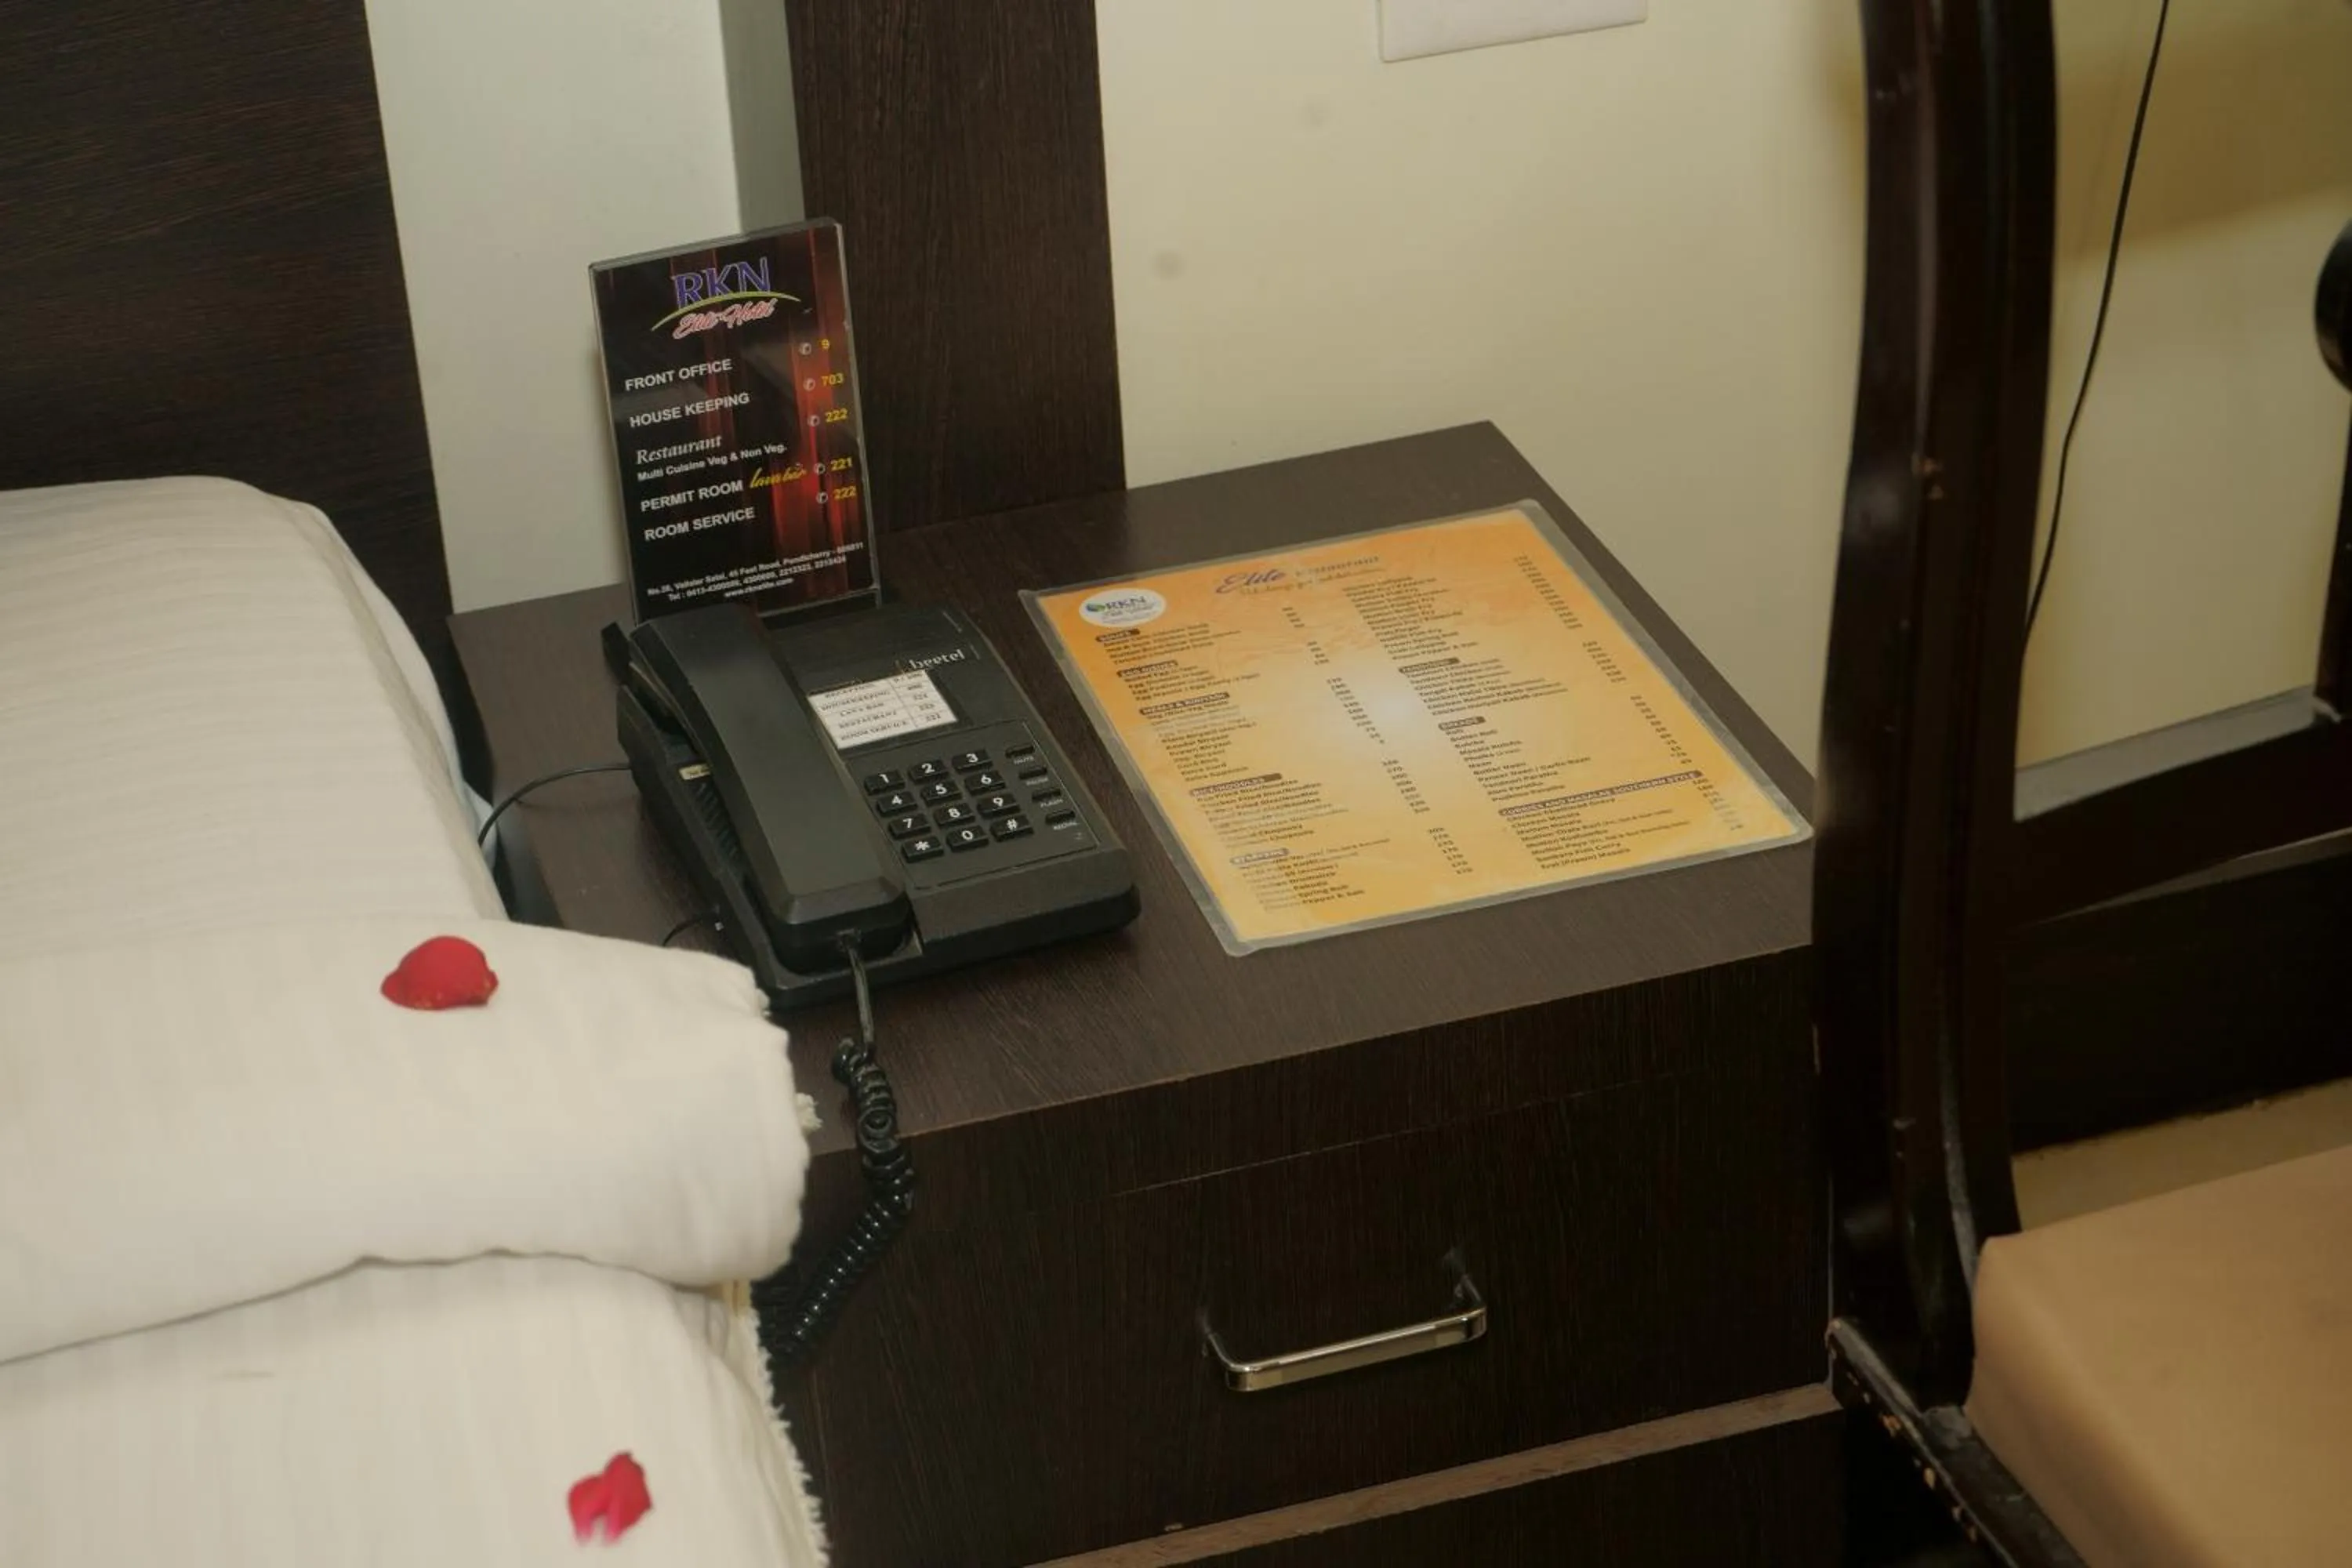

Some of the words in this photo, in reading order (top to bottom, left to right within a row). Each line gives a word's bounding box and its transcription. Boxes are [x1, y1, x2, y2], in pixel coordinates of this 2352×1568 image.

[672, 256, 771, 309] RKN
[821, 338, 830, 350] 9
[625, 372, 674, 391] FRONT
[678, 358, 733, 382] OFFICE
[821, 373, 844, 387] 703
[630, 406, 682, 428] HOUSE
[685, 392, 750, 416] KEEPING
[826, 408, 848, 423] 222
[636, 435, 722, 465] Restaurant
[637, 467, 664, 482] Multi
[666, 459, 706, 476] Cuisine
[708, 454, 729, 469] Veg
[730, 451, 739, 462] &
[740, 448, 763, 459] Non
[831, 457, 853, 472] 221
[641, 489, 696, 512] PERMIT
[699, 480, 743, 499] ROOM
[833, 485, 856, 500] 222
[644, 520, 690, 541] ROOM
[693, 507, 756, 530] SERVICE
[909, 649, 967, 670] beetel
[966, 753, 979, 764] 3
[922, 763, 935, 775] 2
[879, 773, 890, 784] 1
[980, 774, 992, 785] 6
[935, 783, 947, 795] 5
[891, 794, 902, 806] 4
[993, 797, 1004, 808] 9
[948, 808, 960, 818] 8
[903, 818, 914, 829] 7
[961, 830, 974, 841] 0
